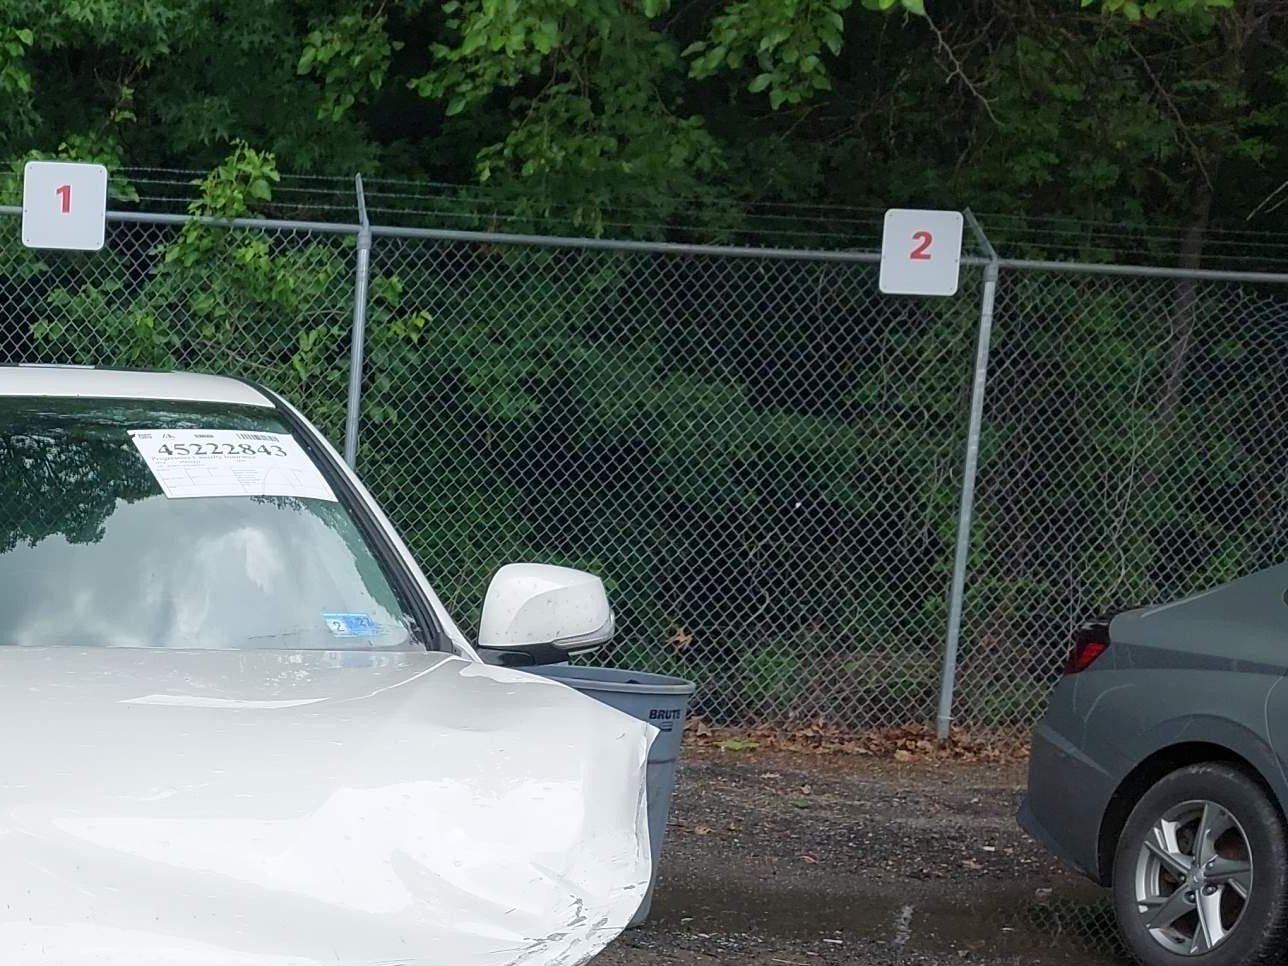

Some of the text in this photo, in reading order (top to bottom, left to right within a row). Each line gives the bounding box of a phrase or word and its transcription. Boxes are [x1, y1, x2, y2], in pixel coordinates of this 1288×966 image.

[56, 185, 72, 213] 1
[910, 231, 933, 260] 2
[158, 442, 288, 457] 45222843
